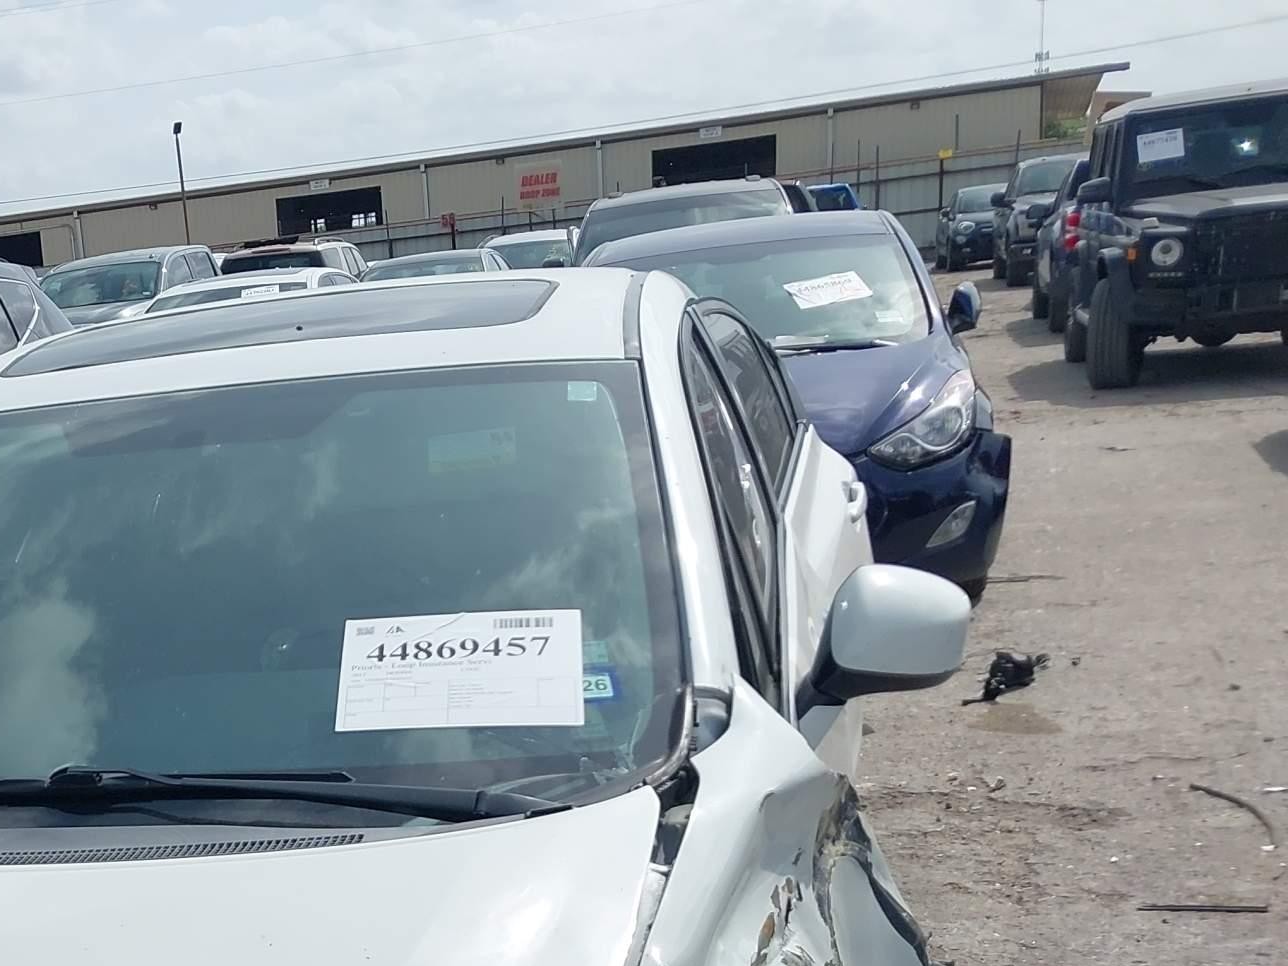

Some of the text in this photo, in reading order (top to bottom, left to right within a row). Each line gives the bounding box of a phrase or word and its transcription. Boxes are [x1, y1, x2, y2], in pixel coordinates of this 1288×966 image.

[520, 172, 558, 187] DEALER
[365, 635, 551, 664] 44869457
[582, 679, 608, 692] 26
